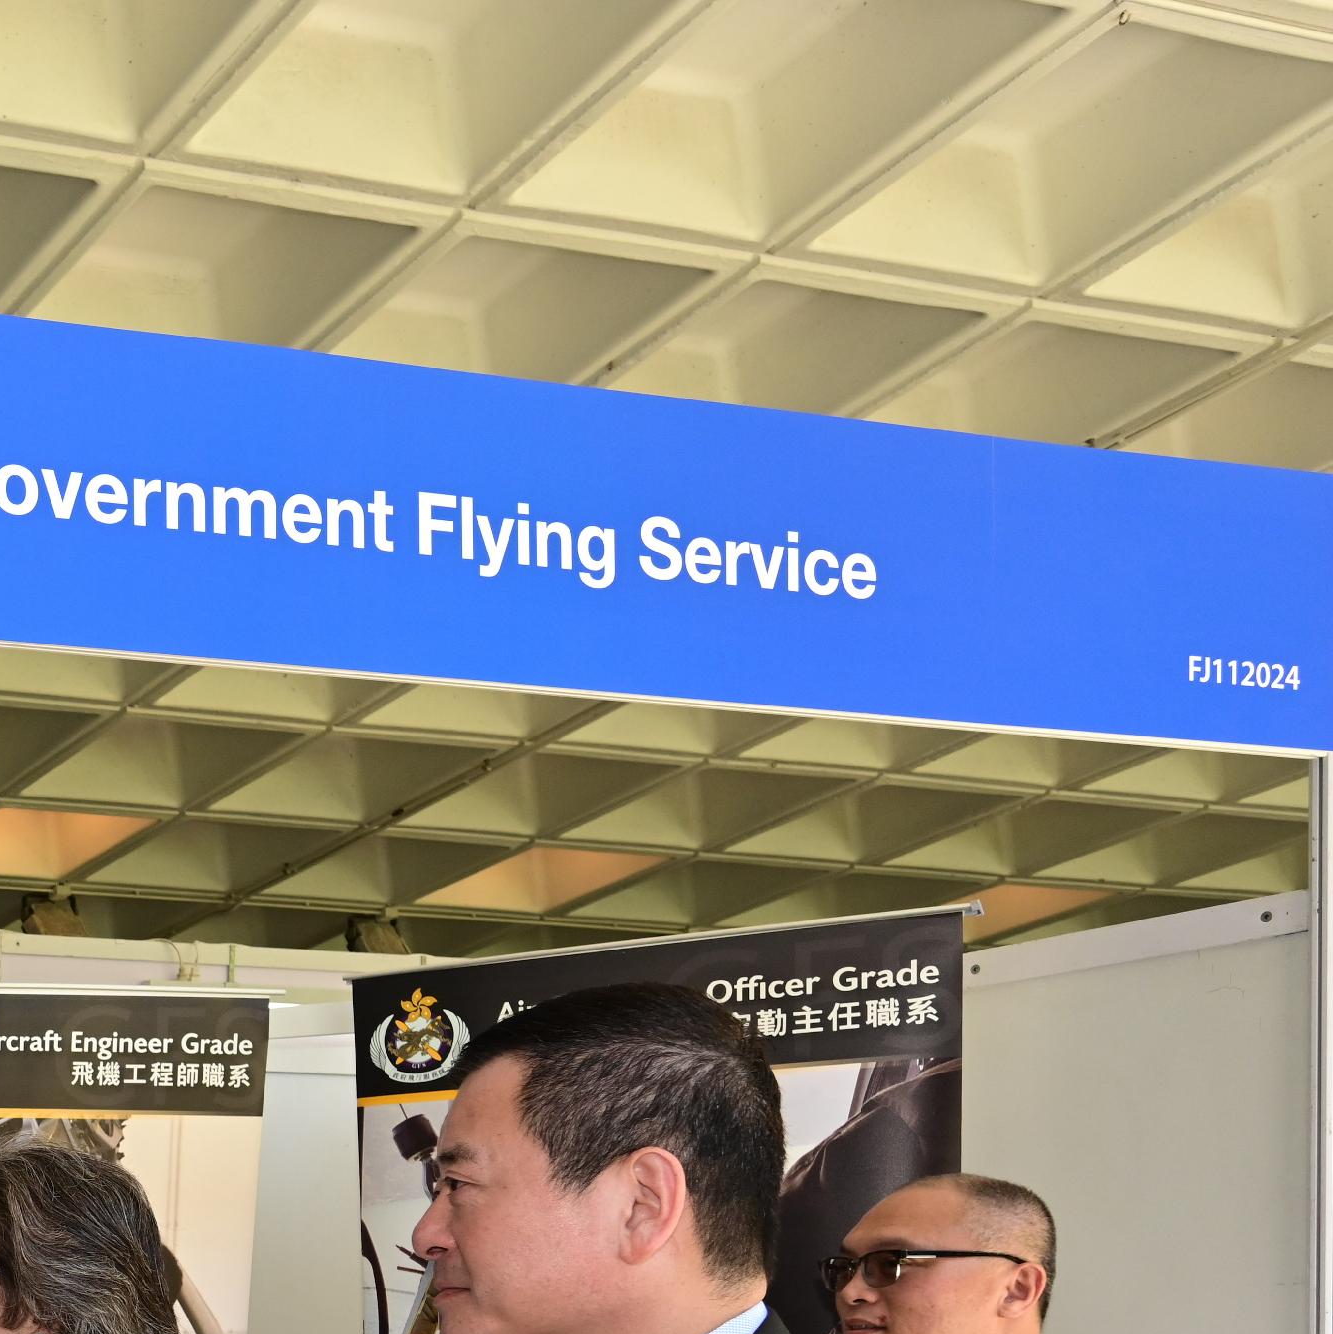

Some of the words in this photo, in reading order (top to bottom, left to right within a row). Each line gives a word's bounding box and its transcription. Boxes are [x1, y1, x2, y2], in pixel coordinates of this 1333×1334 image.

[418, 491, 615, 589] Flying
[639, 515, 877, 599] Service
[1188, 655, 1300, 690] FJ112024
[706, 975, 820, 1004] Officer
[833, 959, 940, 991] Grade
[70, 1031, 174, 1060] Engineer
[181, 1032, 253, 1056] Grade
[71, 1061, 251, 1088] 飛機工程師職系
